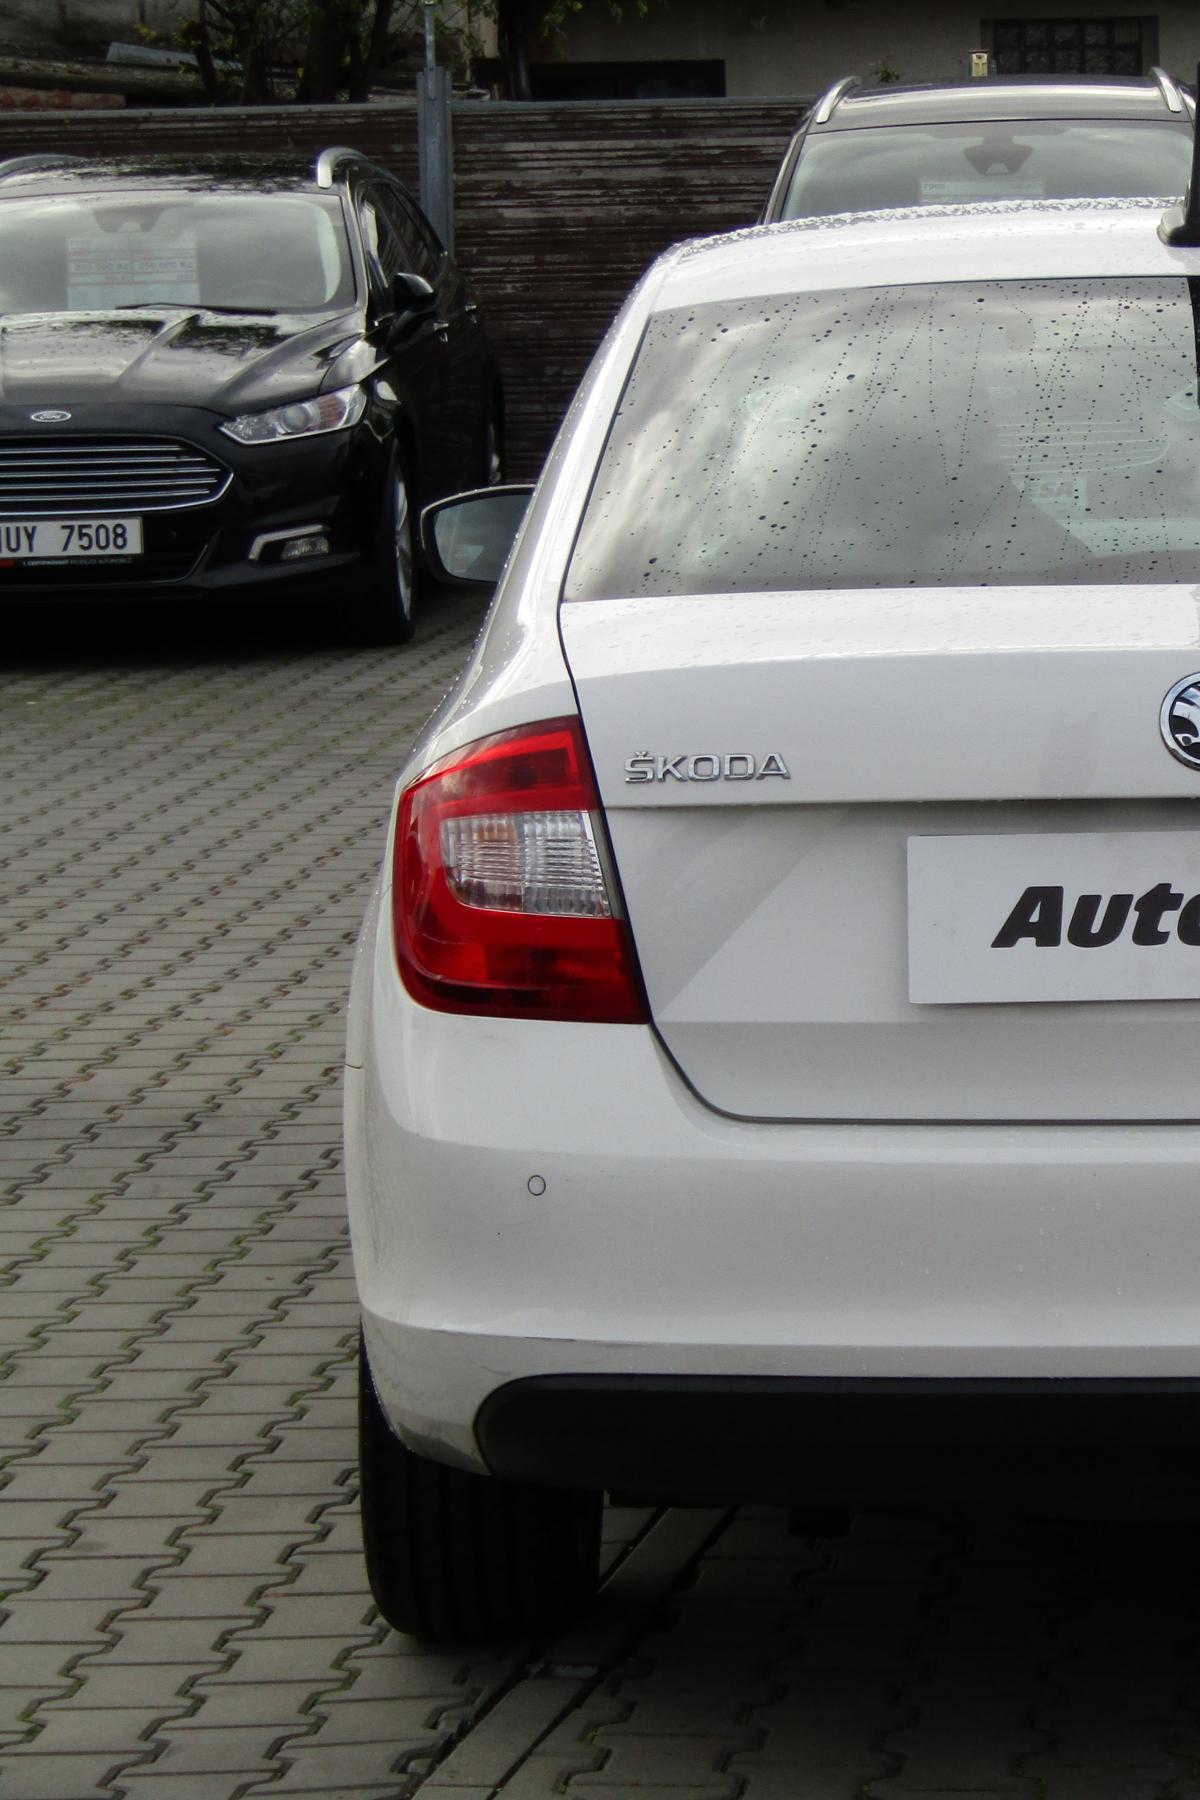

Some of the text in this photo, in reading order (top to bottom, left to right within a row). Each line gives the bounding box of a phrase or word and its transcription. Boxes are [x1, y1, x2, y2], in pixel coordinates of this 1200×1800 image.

[0, 523, 128, 553] UY 7508
[624, 751, 791, 783] ŠKODA
